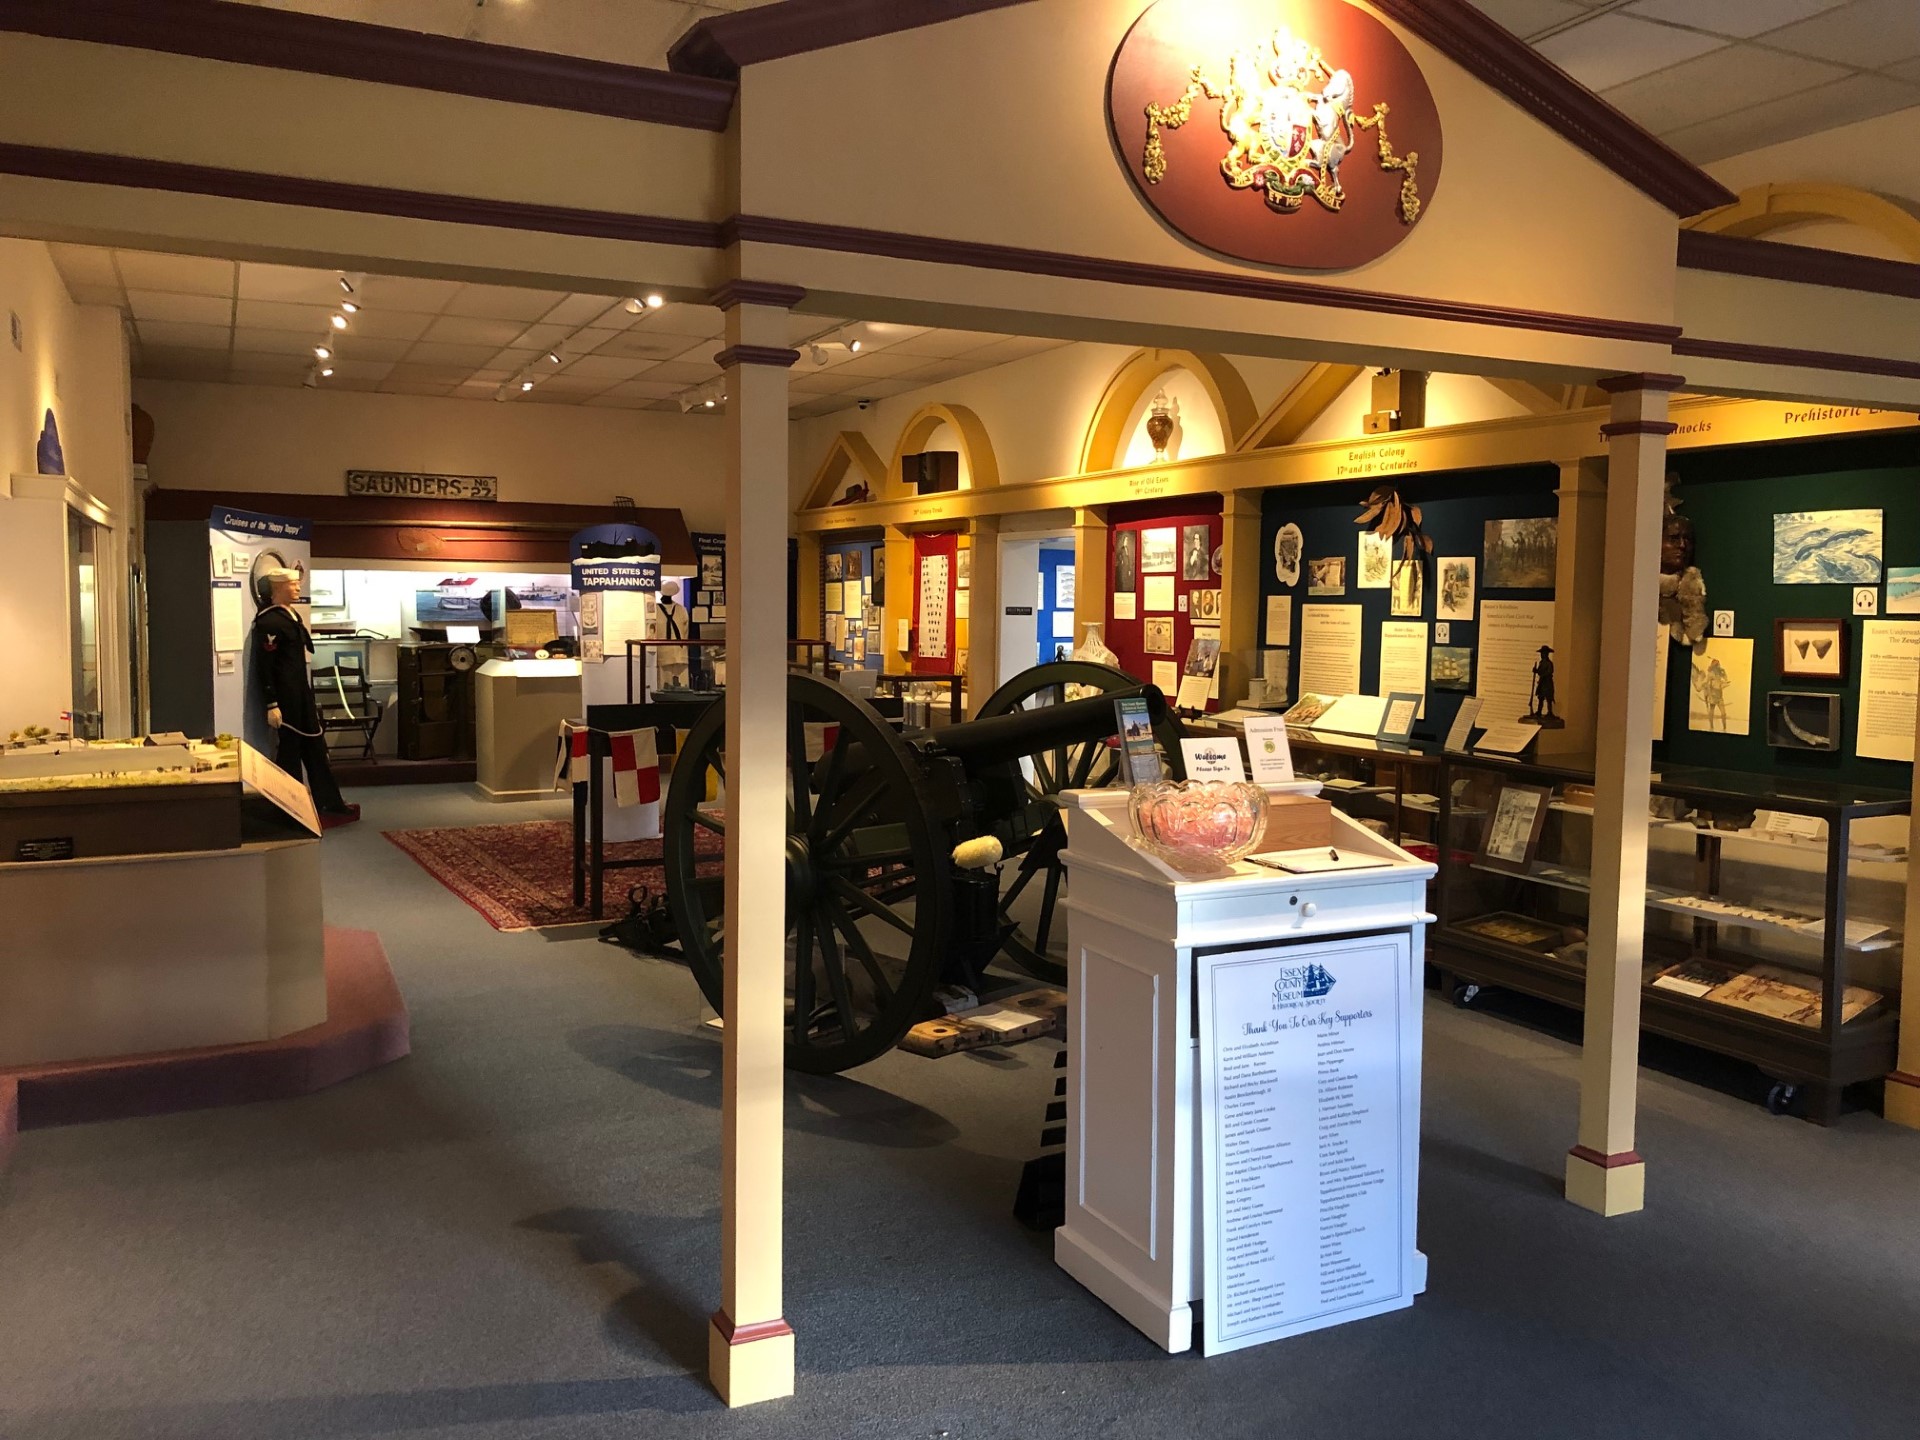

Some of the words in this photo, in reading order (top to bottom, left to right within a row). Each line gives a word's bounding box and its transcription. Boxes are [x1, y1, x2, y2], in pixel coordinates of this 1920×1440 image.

[1268, 190, 1282, 204] ET
[1784, 406, 1861, 424] Prehistoric
[1348, 449, 1376, 462] English
[1379, 447, 1405, 457] Colony
[1348, 464, 1363, 474] and
[1379, 459, 1418, 471] Centuries
[1145, 477, 1155, 485] Old
[224, 514, 249, 528] Cruises
[249, 519, 258, 529] of
[258, 521, 266, 530] the
[581, 567, 609, 576] UNITED
[611, 567, 641, 576] STATES
[582, 577, 656, 588] TAPPAHANNOCK
[1195, 753, 1226, 761] Welcome
[1279, 967, 1303, 980] ESSEX
[1274, 978, 1302, 992] COUNTY
[1272, 990, 1304, 1003] MUSEUM
[1242, 1021, 1267, 1036] Thank
[1269, 1018, 1288, 1033] You
[1288, 1015, 1300, 1029] To
[1301, 1014, 1317, 1028] Our
[1318, 1011, 1333, 1030] Key
[1334, 1009, 1373, 1027] Supporters
